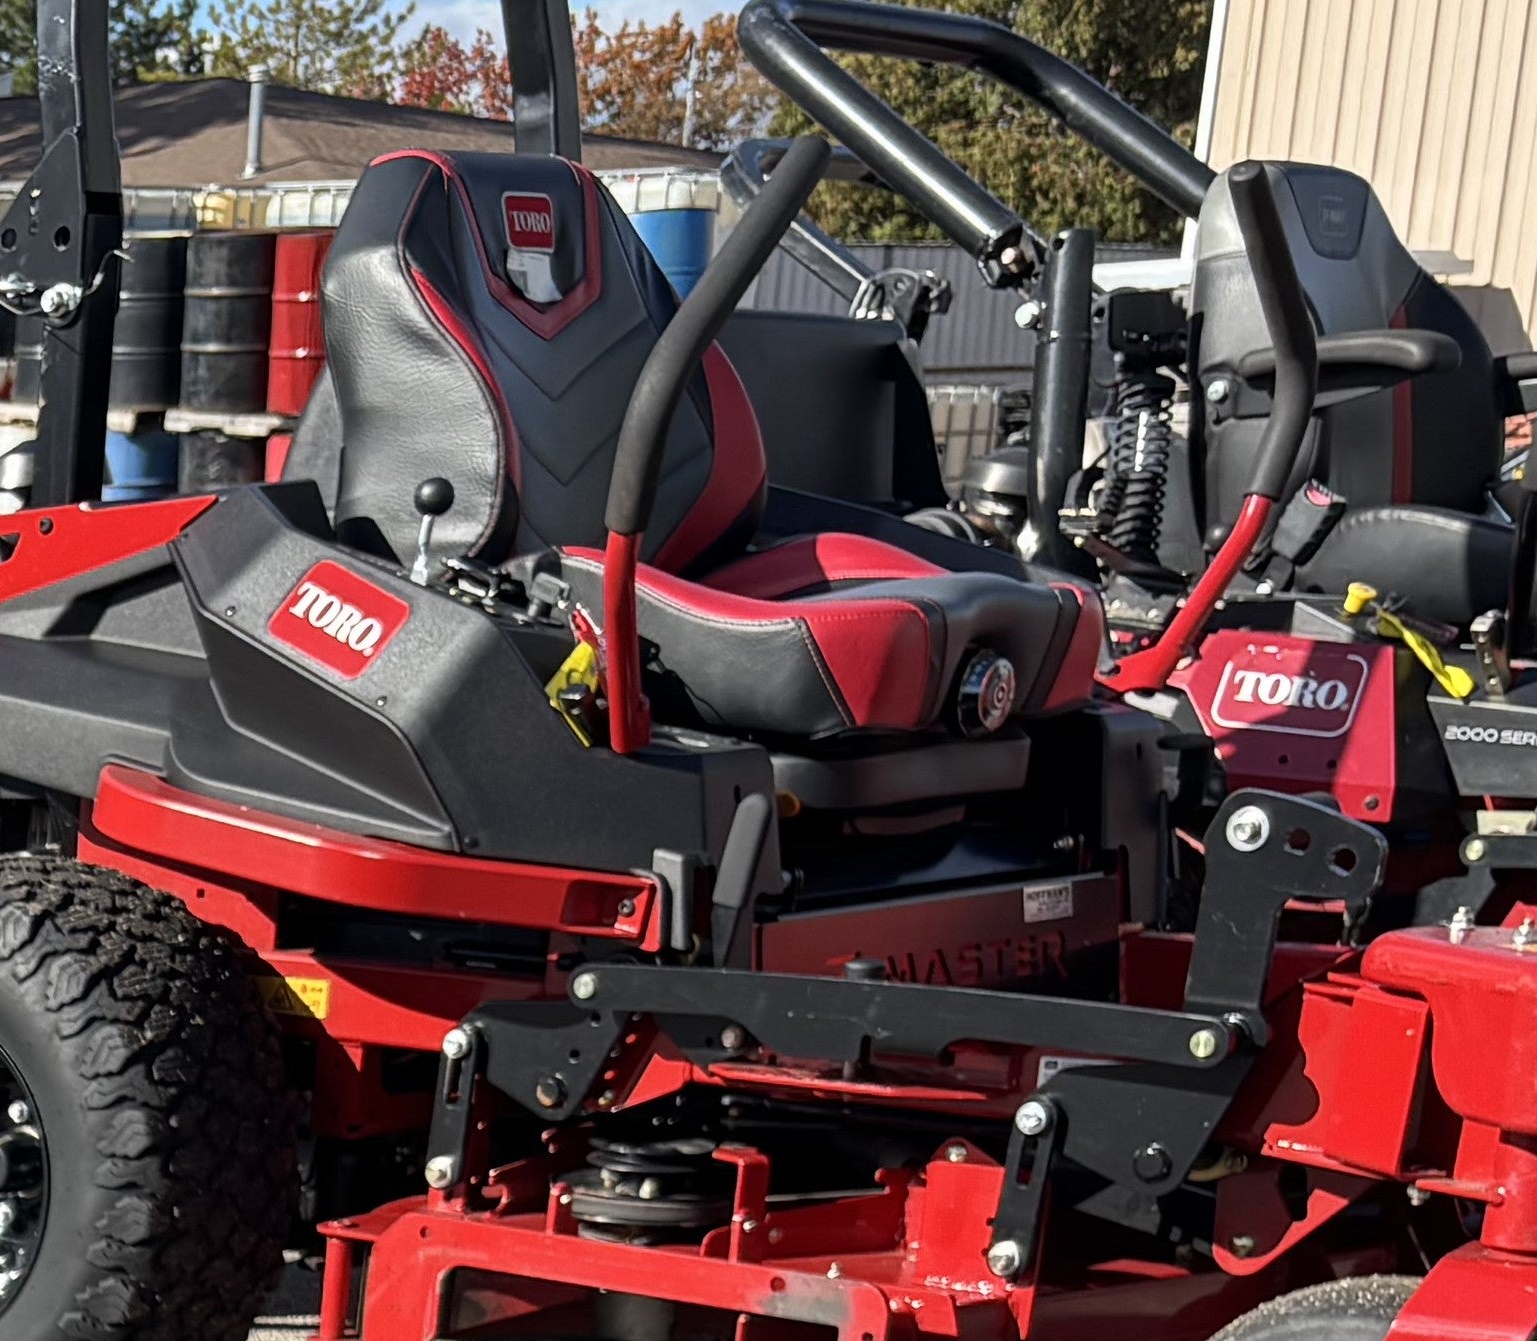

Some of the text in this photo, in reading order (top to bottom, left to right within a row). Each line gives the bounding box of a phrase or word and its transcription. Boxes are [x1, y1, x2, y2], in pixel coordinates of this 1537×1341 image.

[509, 210, 552, 234] TORO
[288, 581, 383, 653] TORO
[1233, 669, 1349, 711] TORO
[1444, 725, 1499, 743] 2000
